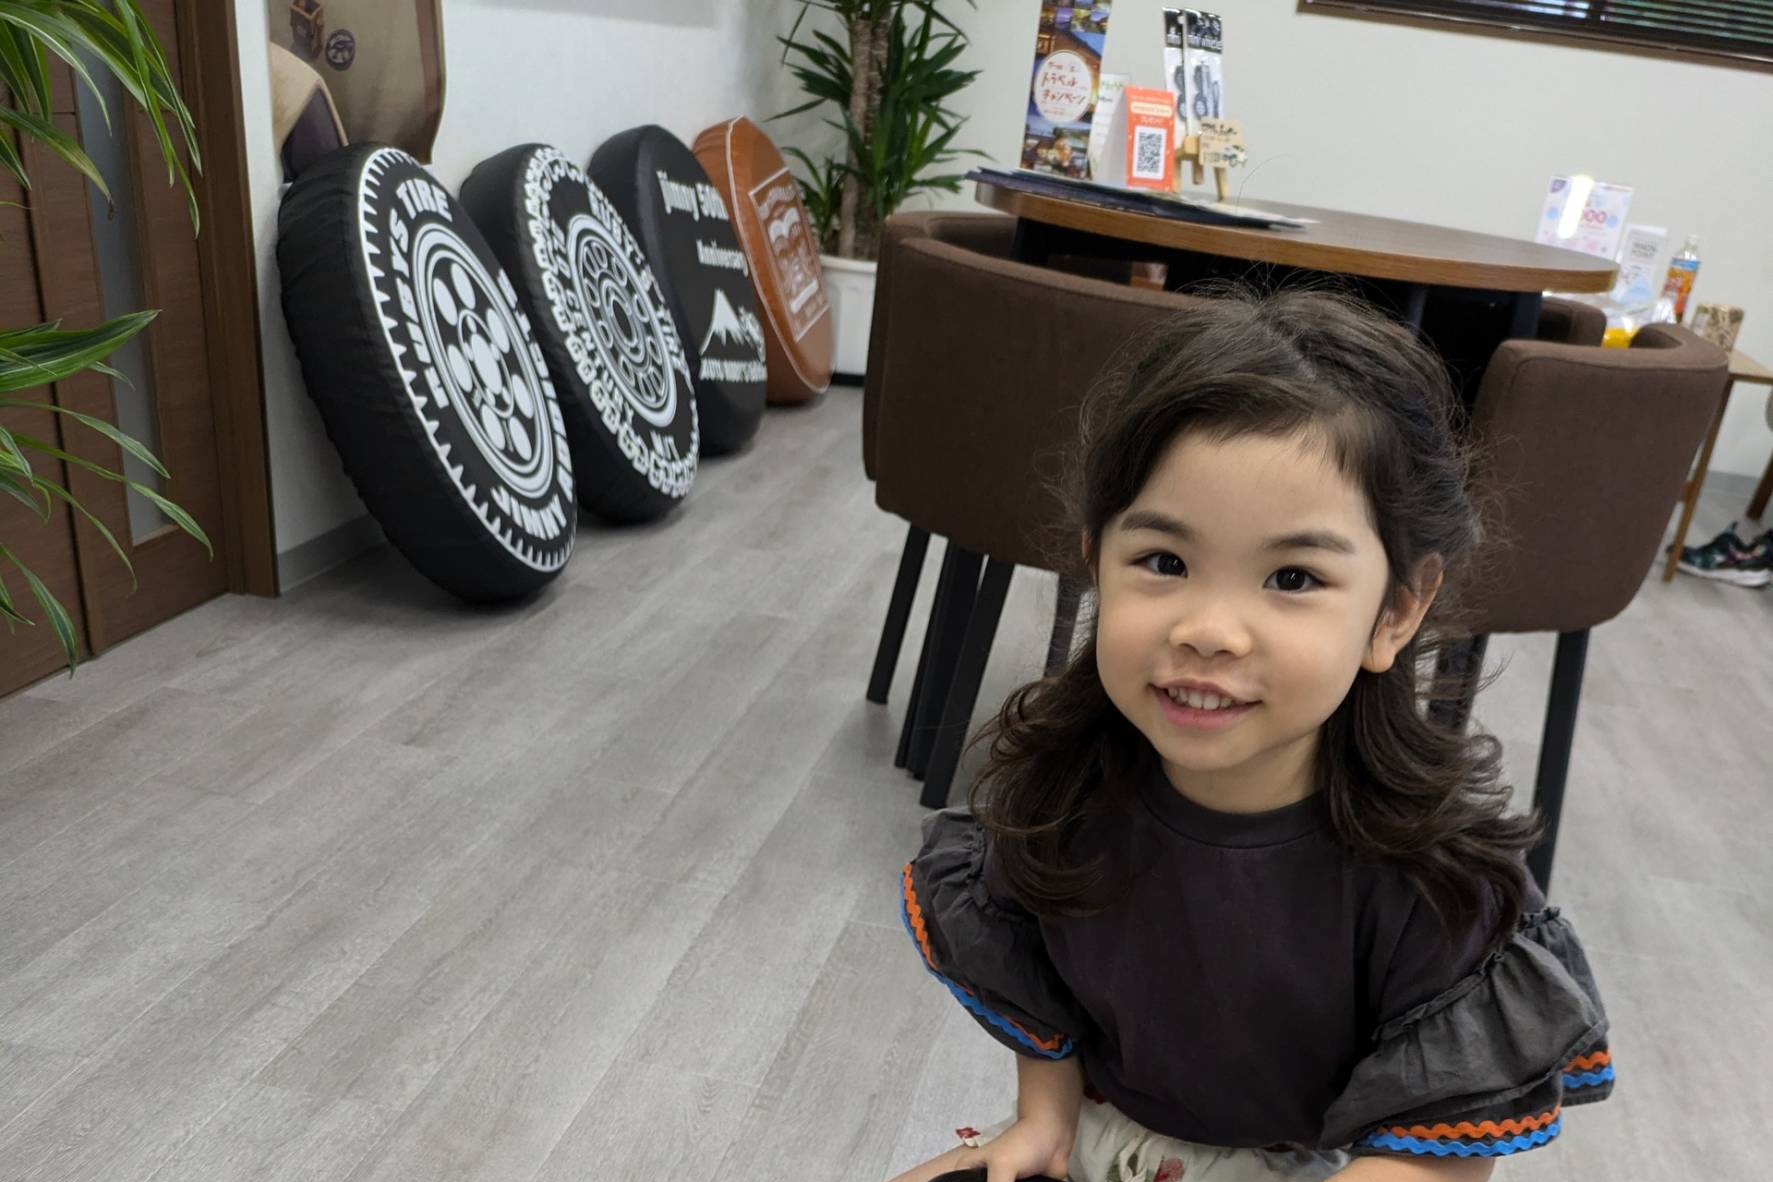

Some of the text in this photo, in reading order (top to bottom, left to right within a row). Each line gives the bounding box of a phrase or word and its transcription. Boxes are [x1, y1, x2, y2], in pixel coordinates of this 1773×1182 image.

[1042, 88, 1087, 105] キャンペーン
[388, 178, 454, 409] RUBYS TIRE
[490, 486, 568, 541] JIMNY
